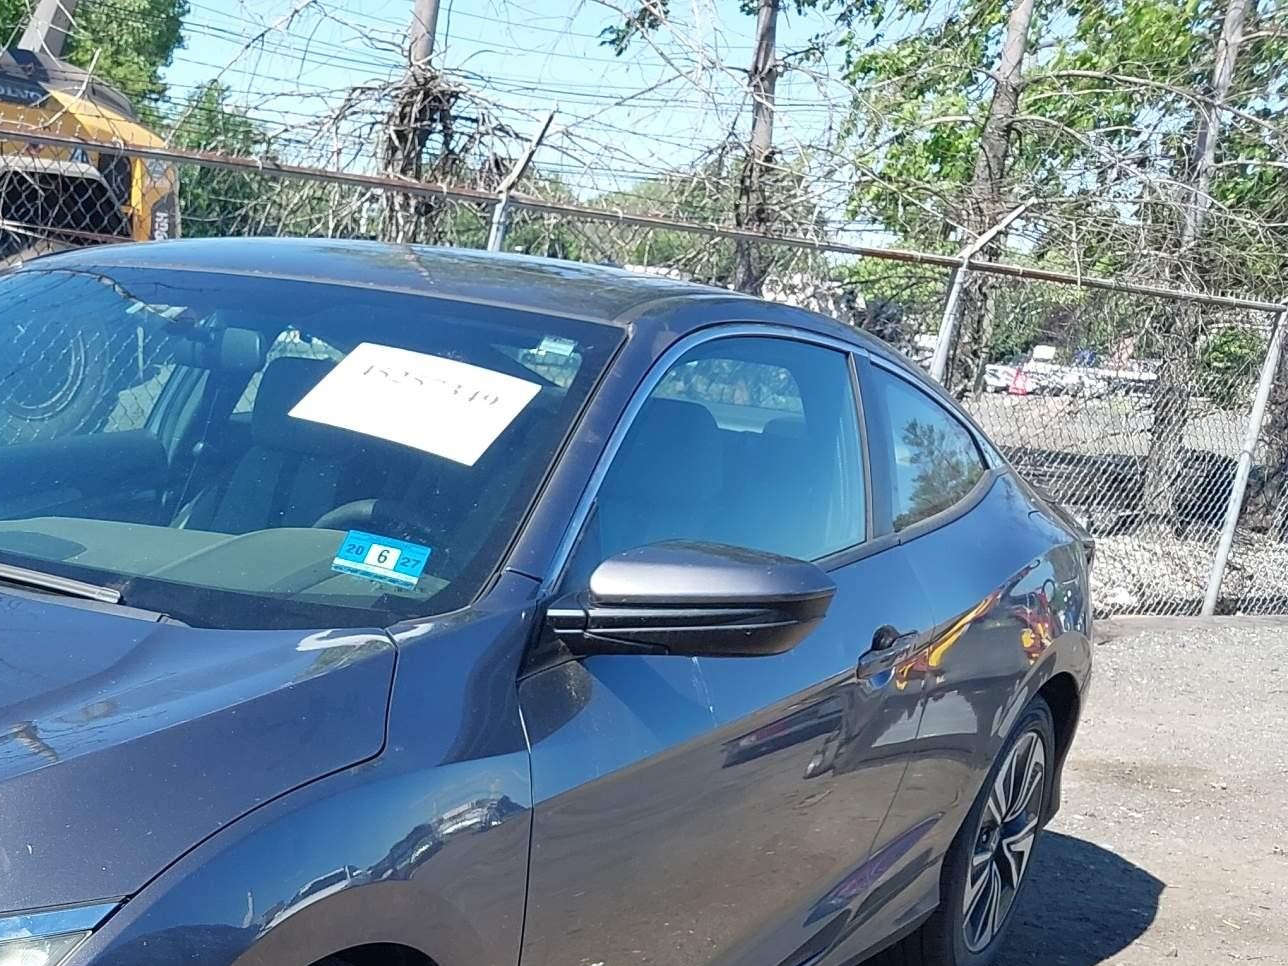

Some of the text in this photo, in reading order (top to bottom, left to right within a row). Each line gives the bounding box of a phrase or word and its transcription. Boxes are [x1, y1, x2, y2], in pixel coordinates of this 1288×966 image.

[345, 543, 365, 556] 20
[377, 549, 391, 564] 6
[399, 557, 421, 569] 27
